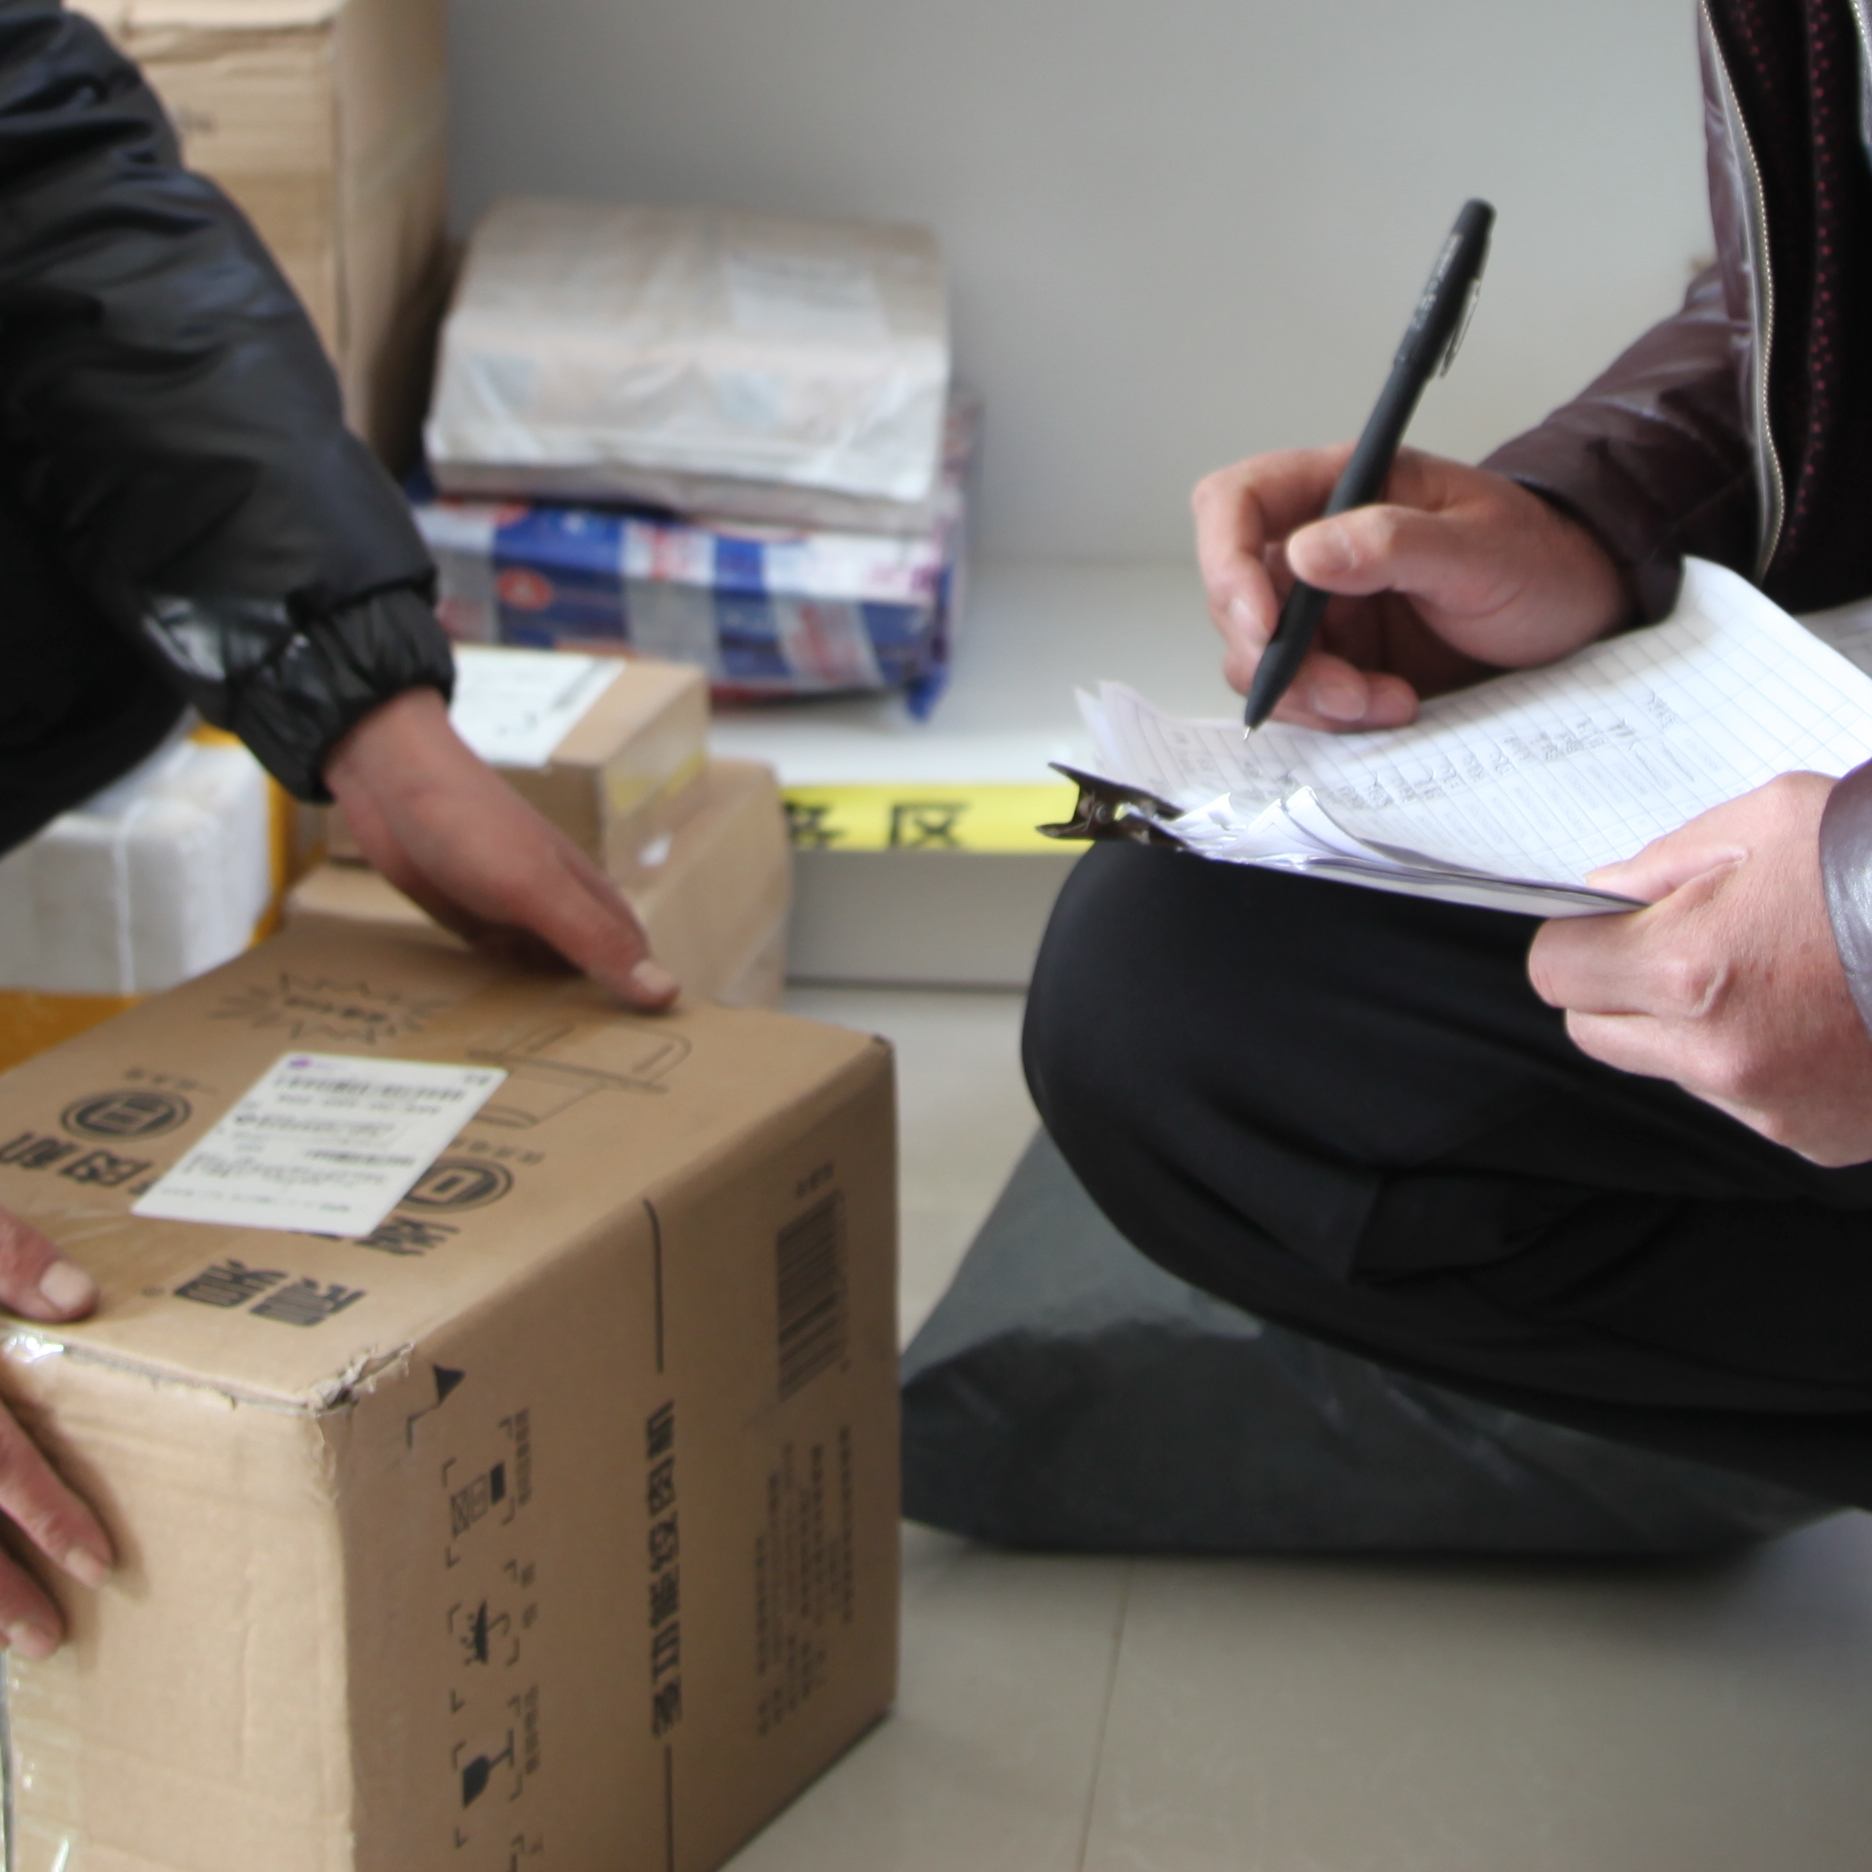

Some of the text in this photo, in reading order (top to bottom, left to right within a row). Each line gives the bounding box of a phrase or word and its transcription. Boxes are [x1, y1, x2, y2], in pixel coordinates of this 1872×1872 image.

[645, 1398, 682, 1739] 多功能绞肉机
